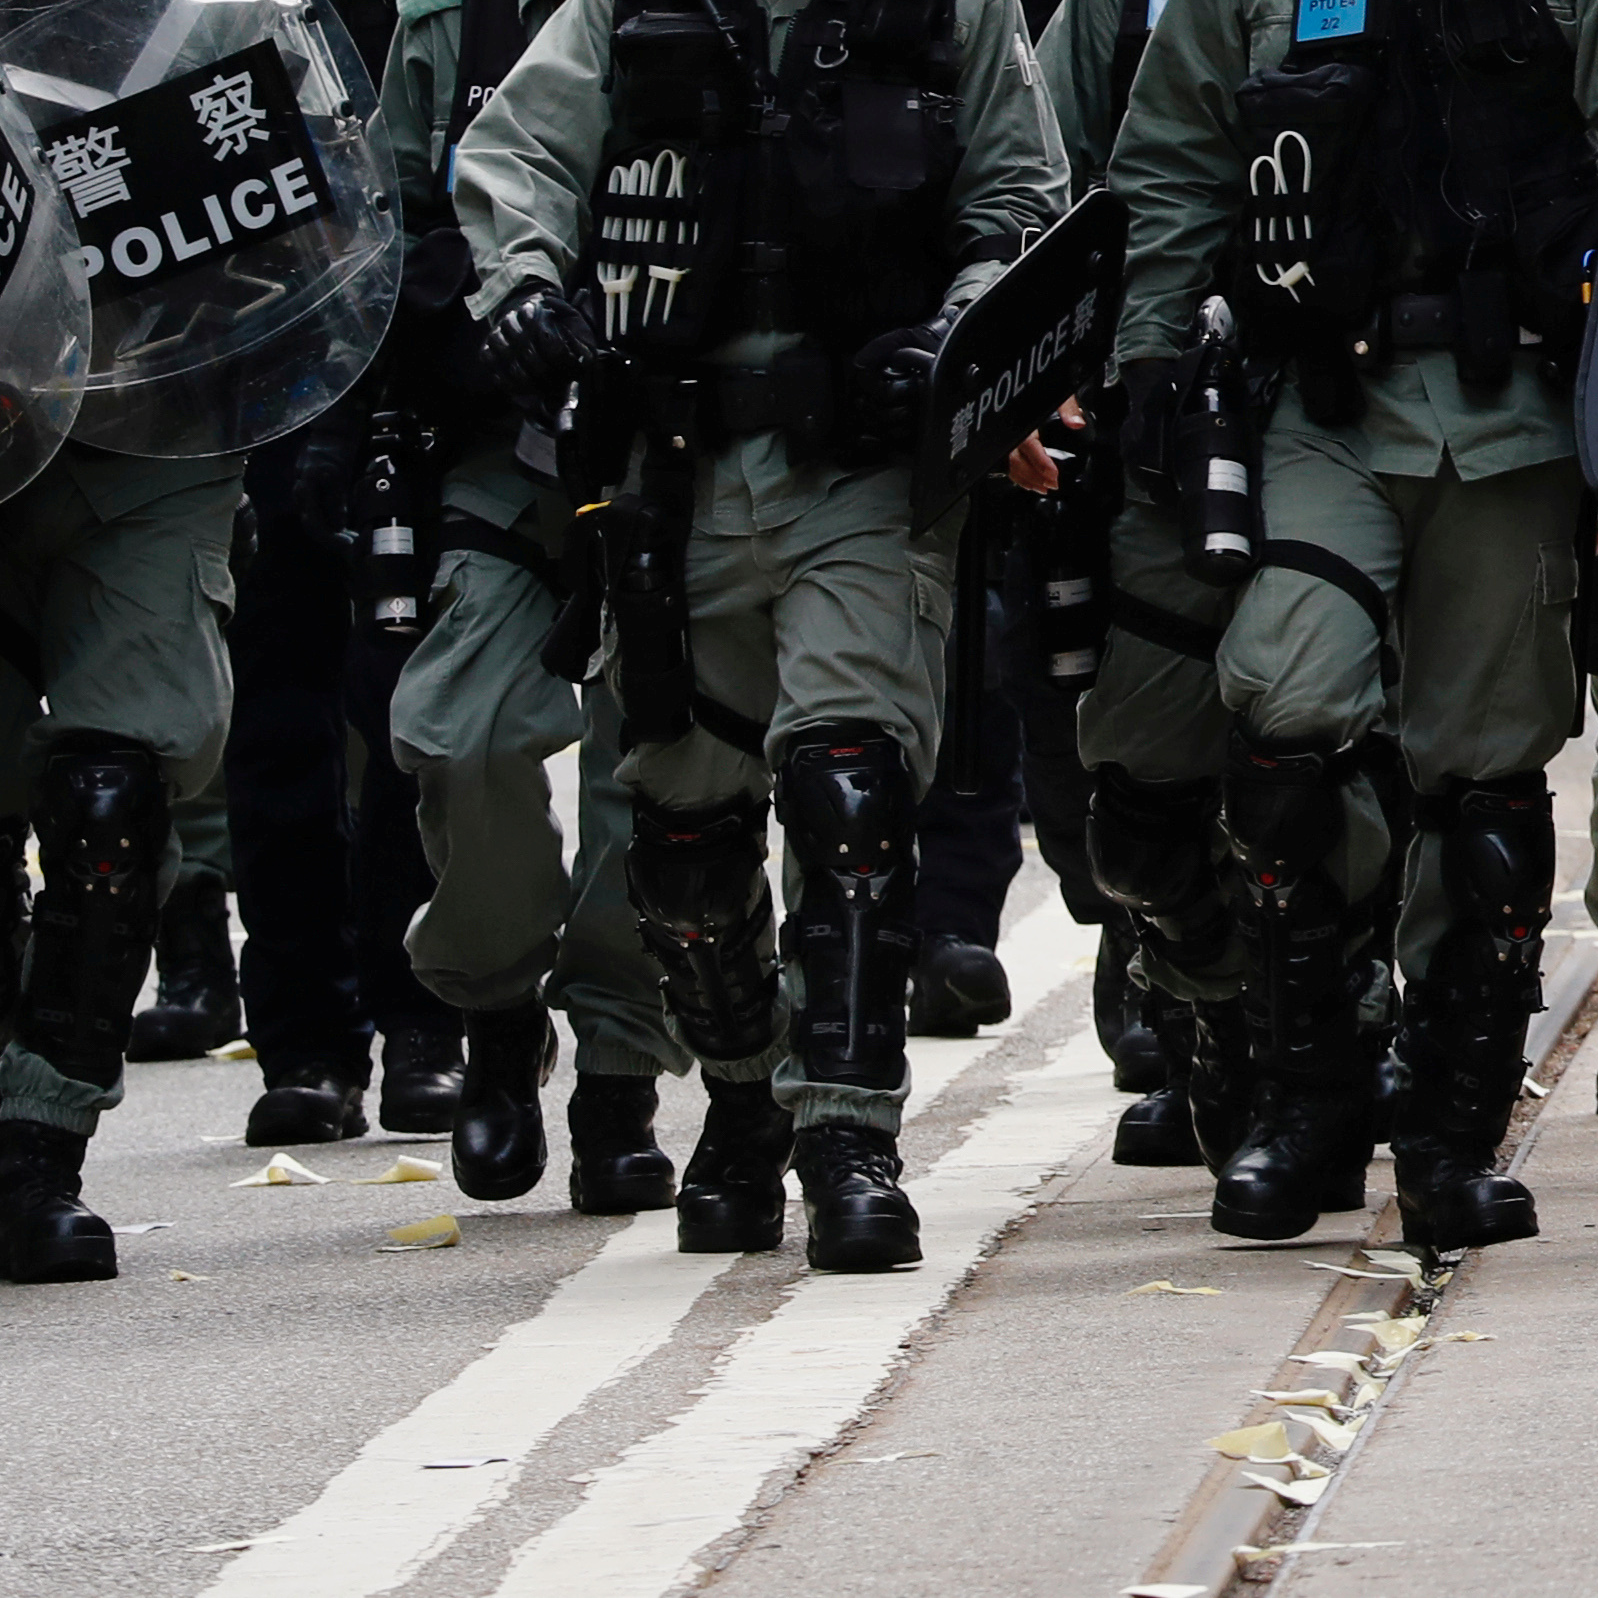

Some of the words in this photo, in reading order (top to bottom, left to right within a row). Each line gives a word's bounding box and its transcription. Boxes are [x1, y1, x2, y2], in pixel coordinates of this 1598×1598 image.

[1320, 17, 1341, 30] 2/2
[47, 70, 271, 219] 警察
[62, 157, 318, 280] POLICE
[976, 314, 1070, 432] POLICE
